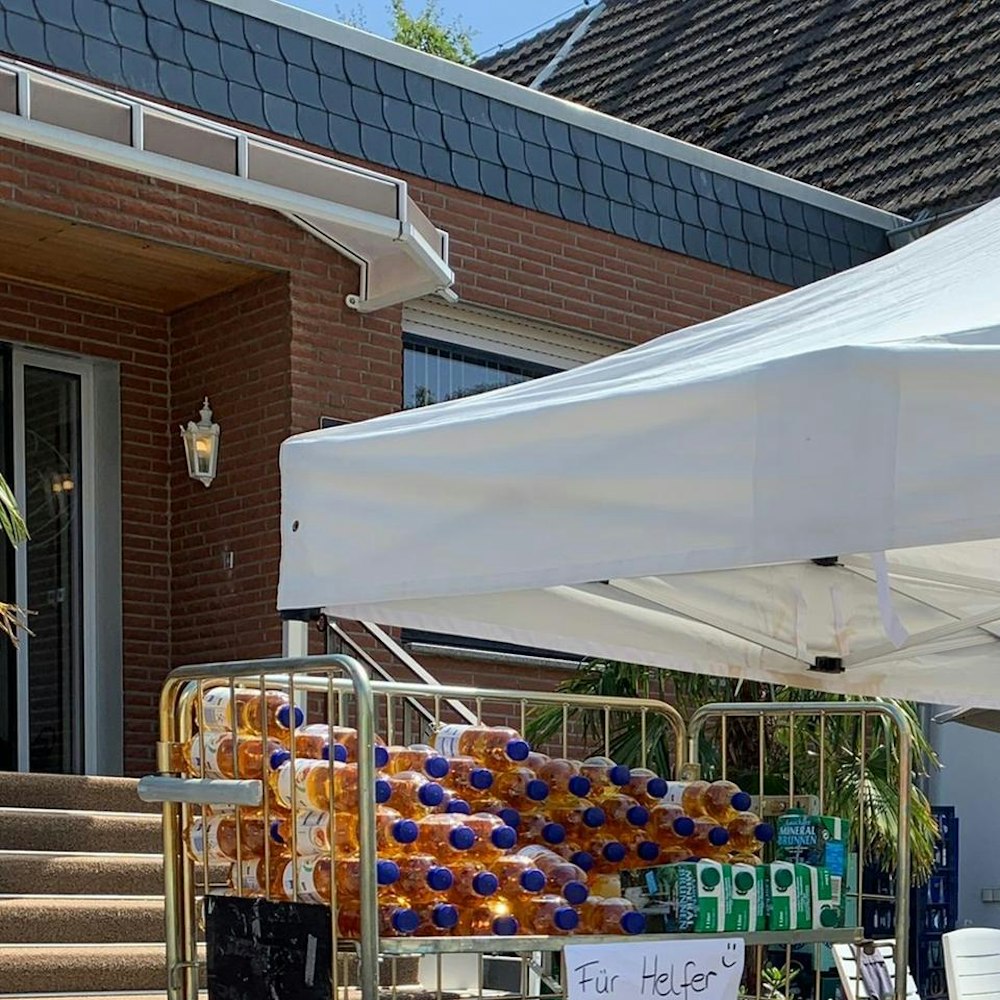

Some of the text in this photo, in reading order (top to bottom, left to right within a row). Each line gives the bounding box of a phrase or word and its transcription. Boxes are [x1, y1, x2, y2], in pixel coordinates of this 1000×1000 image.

[778, 834, 817, 845] BRUNNEN
[779, 825, 816, 835] MINERAL
[686, 870, 694, 925] MINERAL
[574, 959, 620, 994] Für
